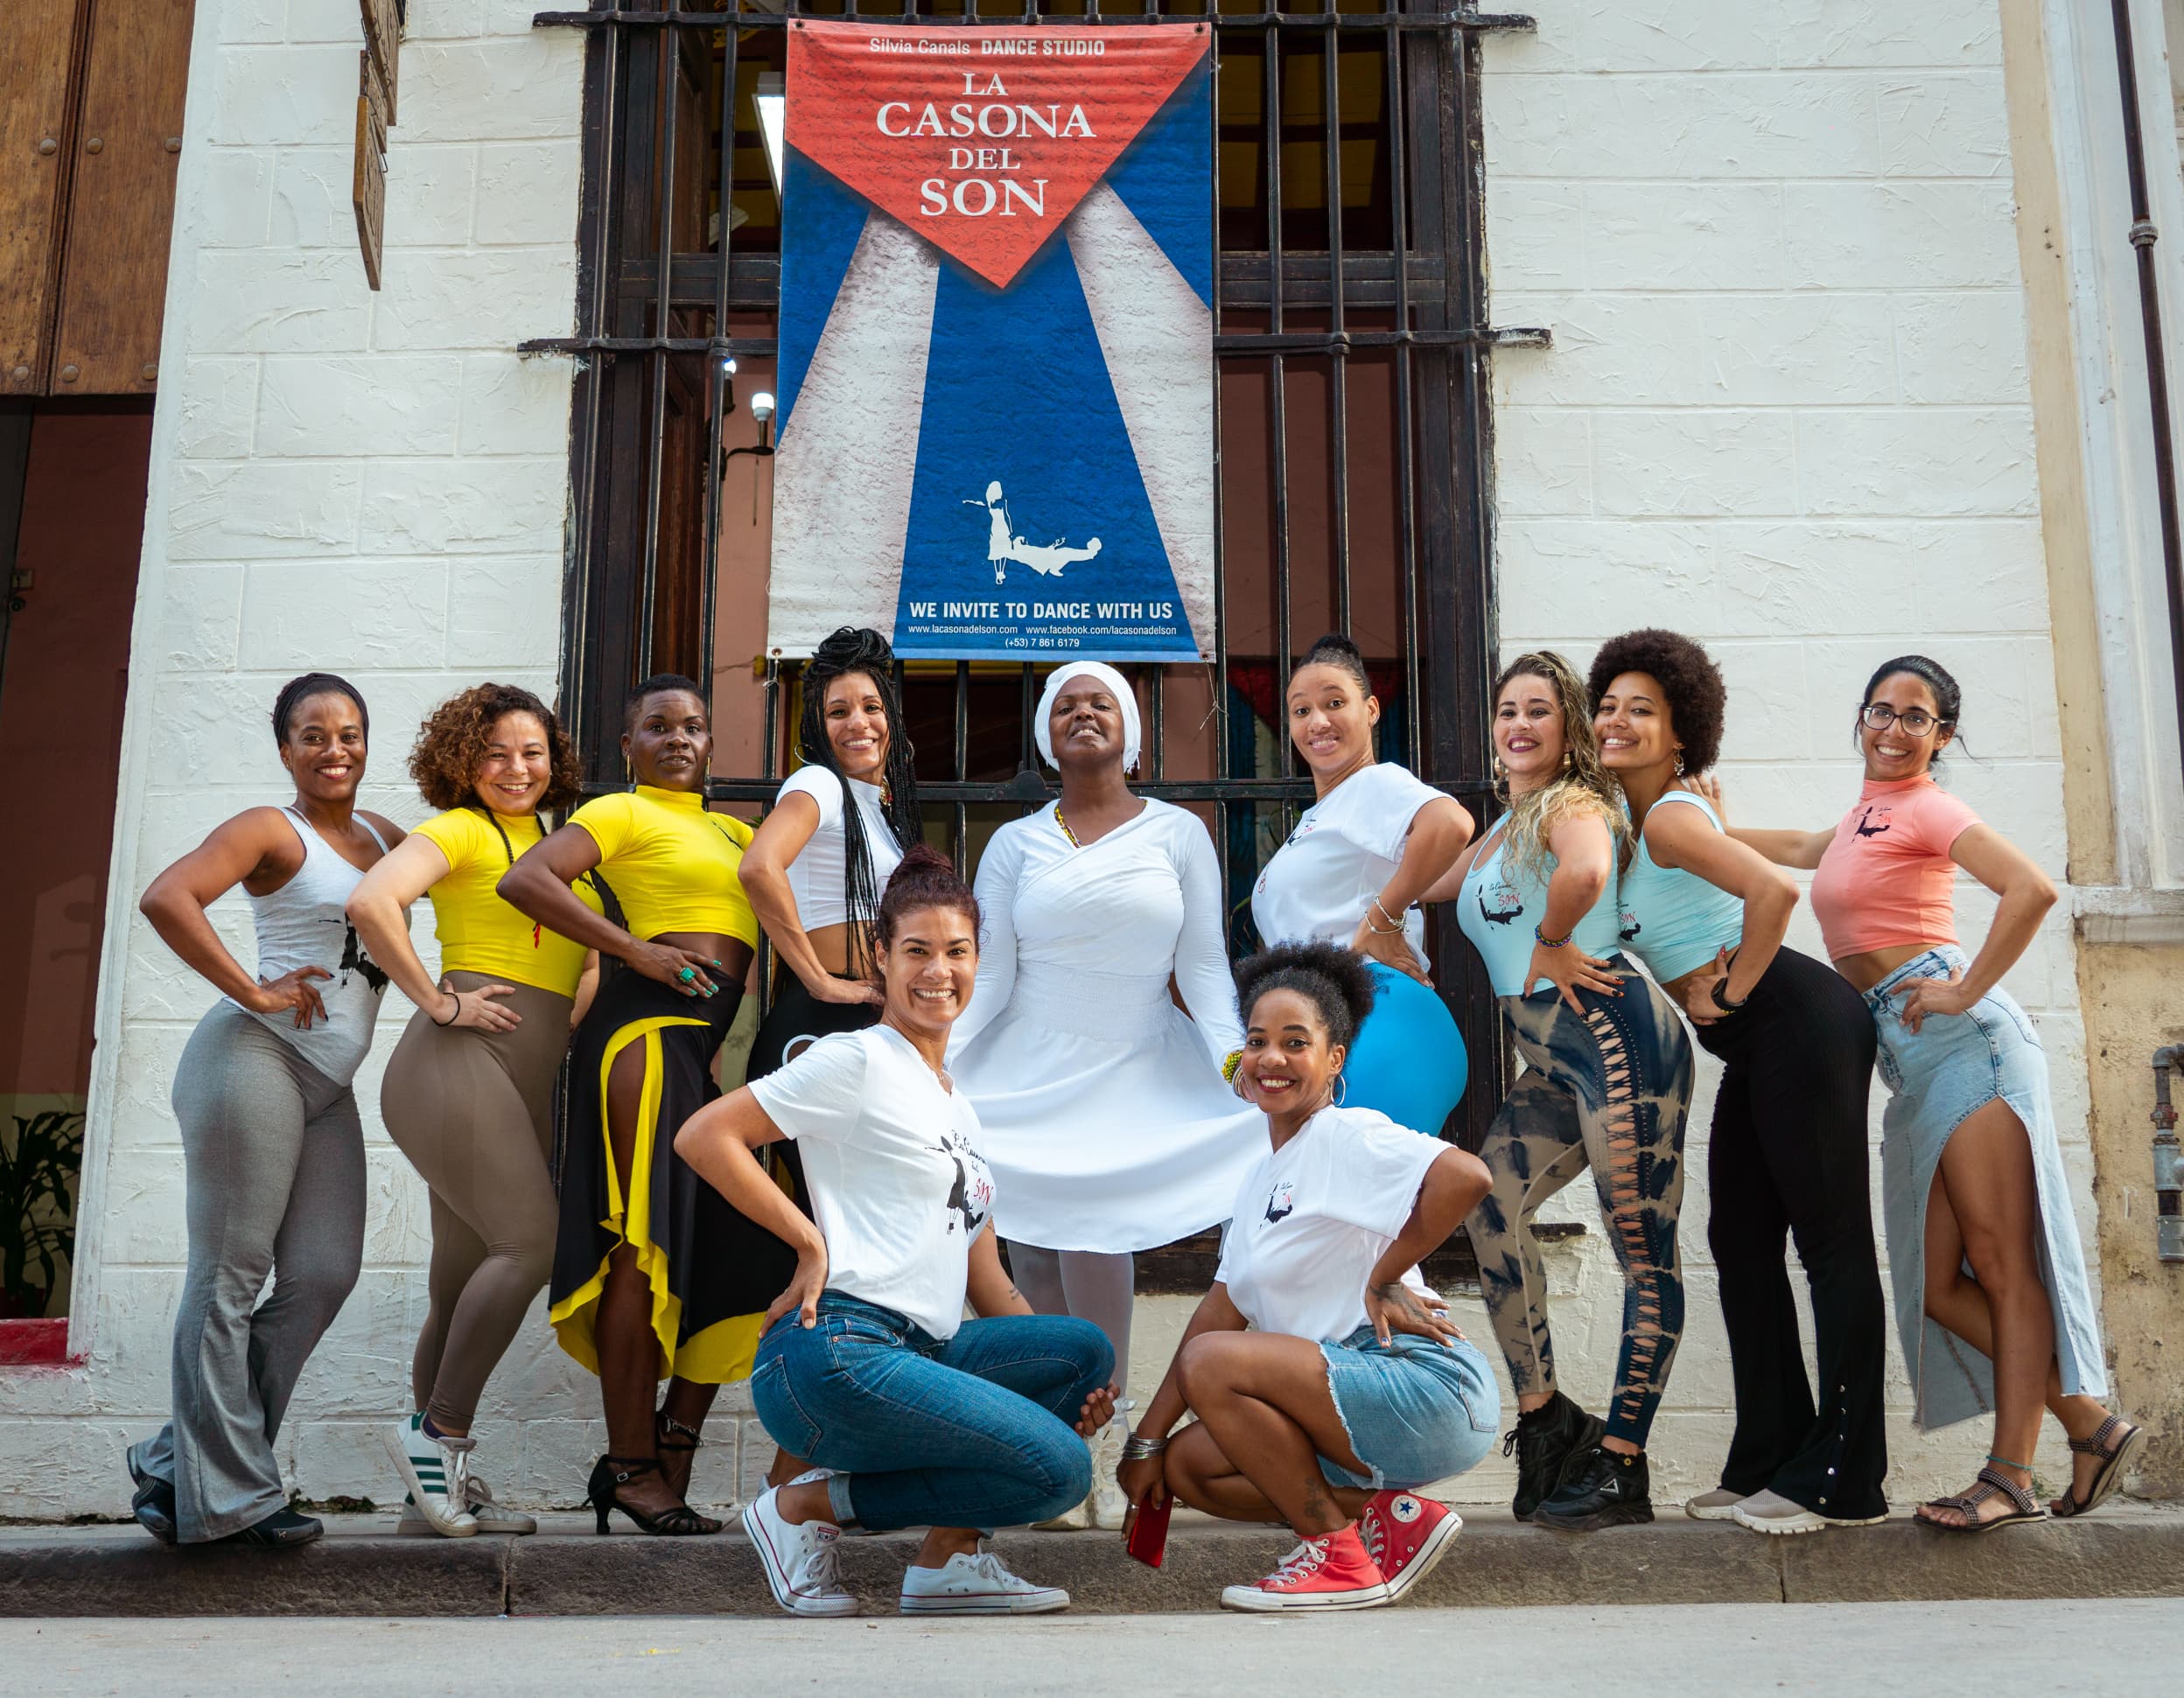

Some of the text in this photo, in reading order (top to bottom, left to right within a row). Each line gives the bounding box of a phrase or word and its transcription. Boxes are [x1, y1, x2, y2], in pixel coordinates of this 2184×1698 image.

[870, 38, 1105, 56] Silvia Canals DANCE STUDIO
[962, 73, 1008, 96] LA
[876, 102, 1097, 138] CASONA
[948, 148, 1021, 171] DEL
[920, 178, 1048, 217] SON
[910, 602, 1172, 619] WE INVITE TO DANCE WITH US
[908, 625, 1177, 636] www.lacasonadelson.com www.facebook.com/lacasonadelson
[1004, 638, 1080, 648] (+53) 7 861 6179
